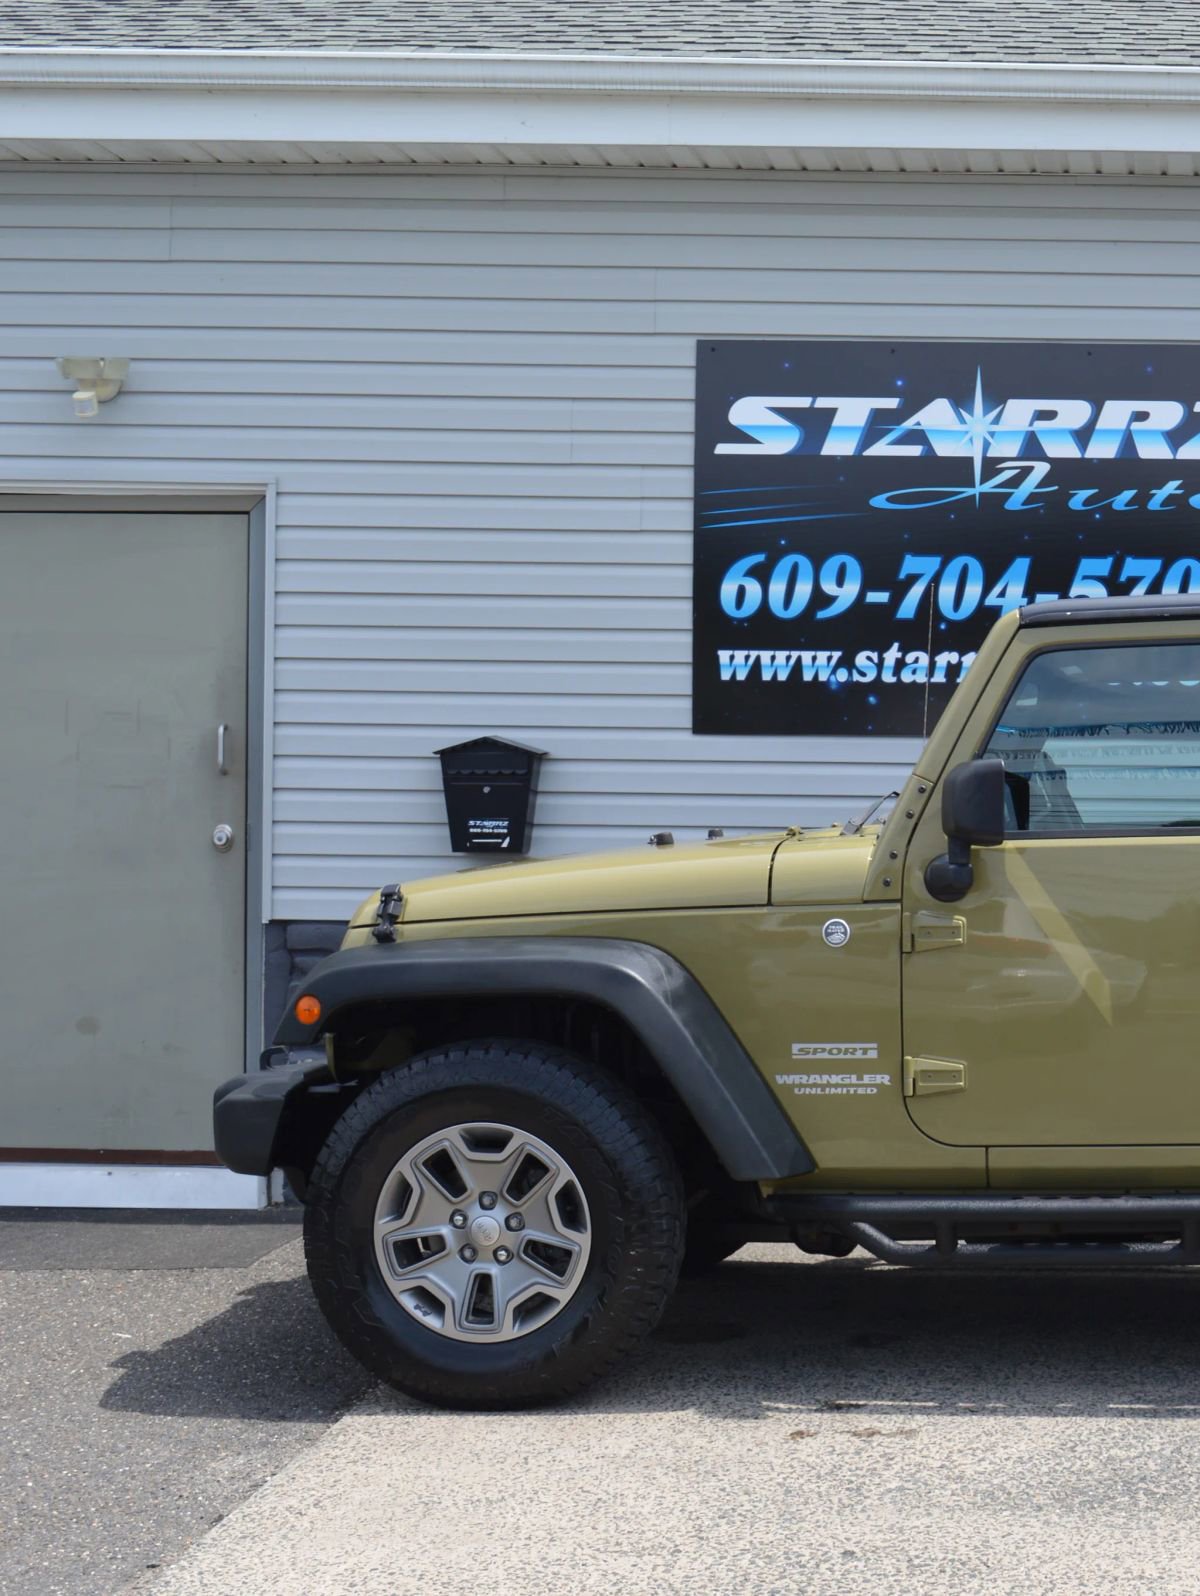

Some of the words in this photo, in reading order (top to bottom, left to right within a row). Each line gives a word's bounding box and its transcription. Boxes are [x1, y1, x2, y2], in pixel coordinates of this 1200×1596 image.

[792, 1046, 878, 1057] SPORT
[775, 1074, 891, 1085] WRANGLER
[794, 1087, 878, 1095] UNLIMITED
